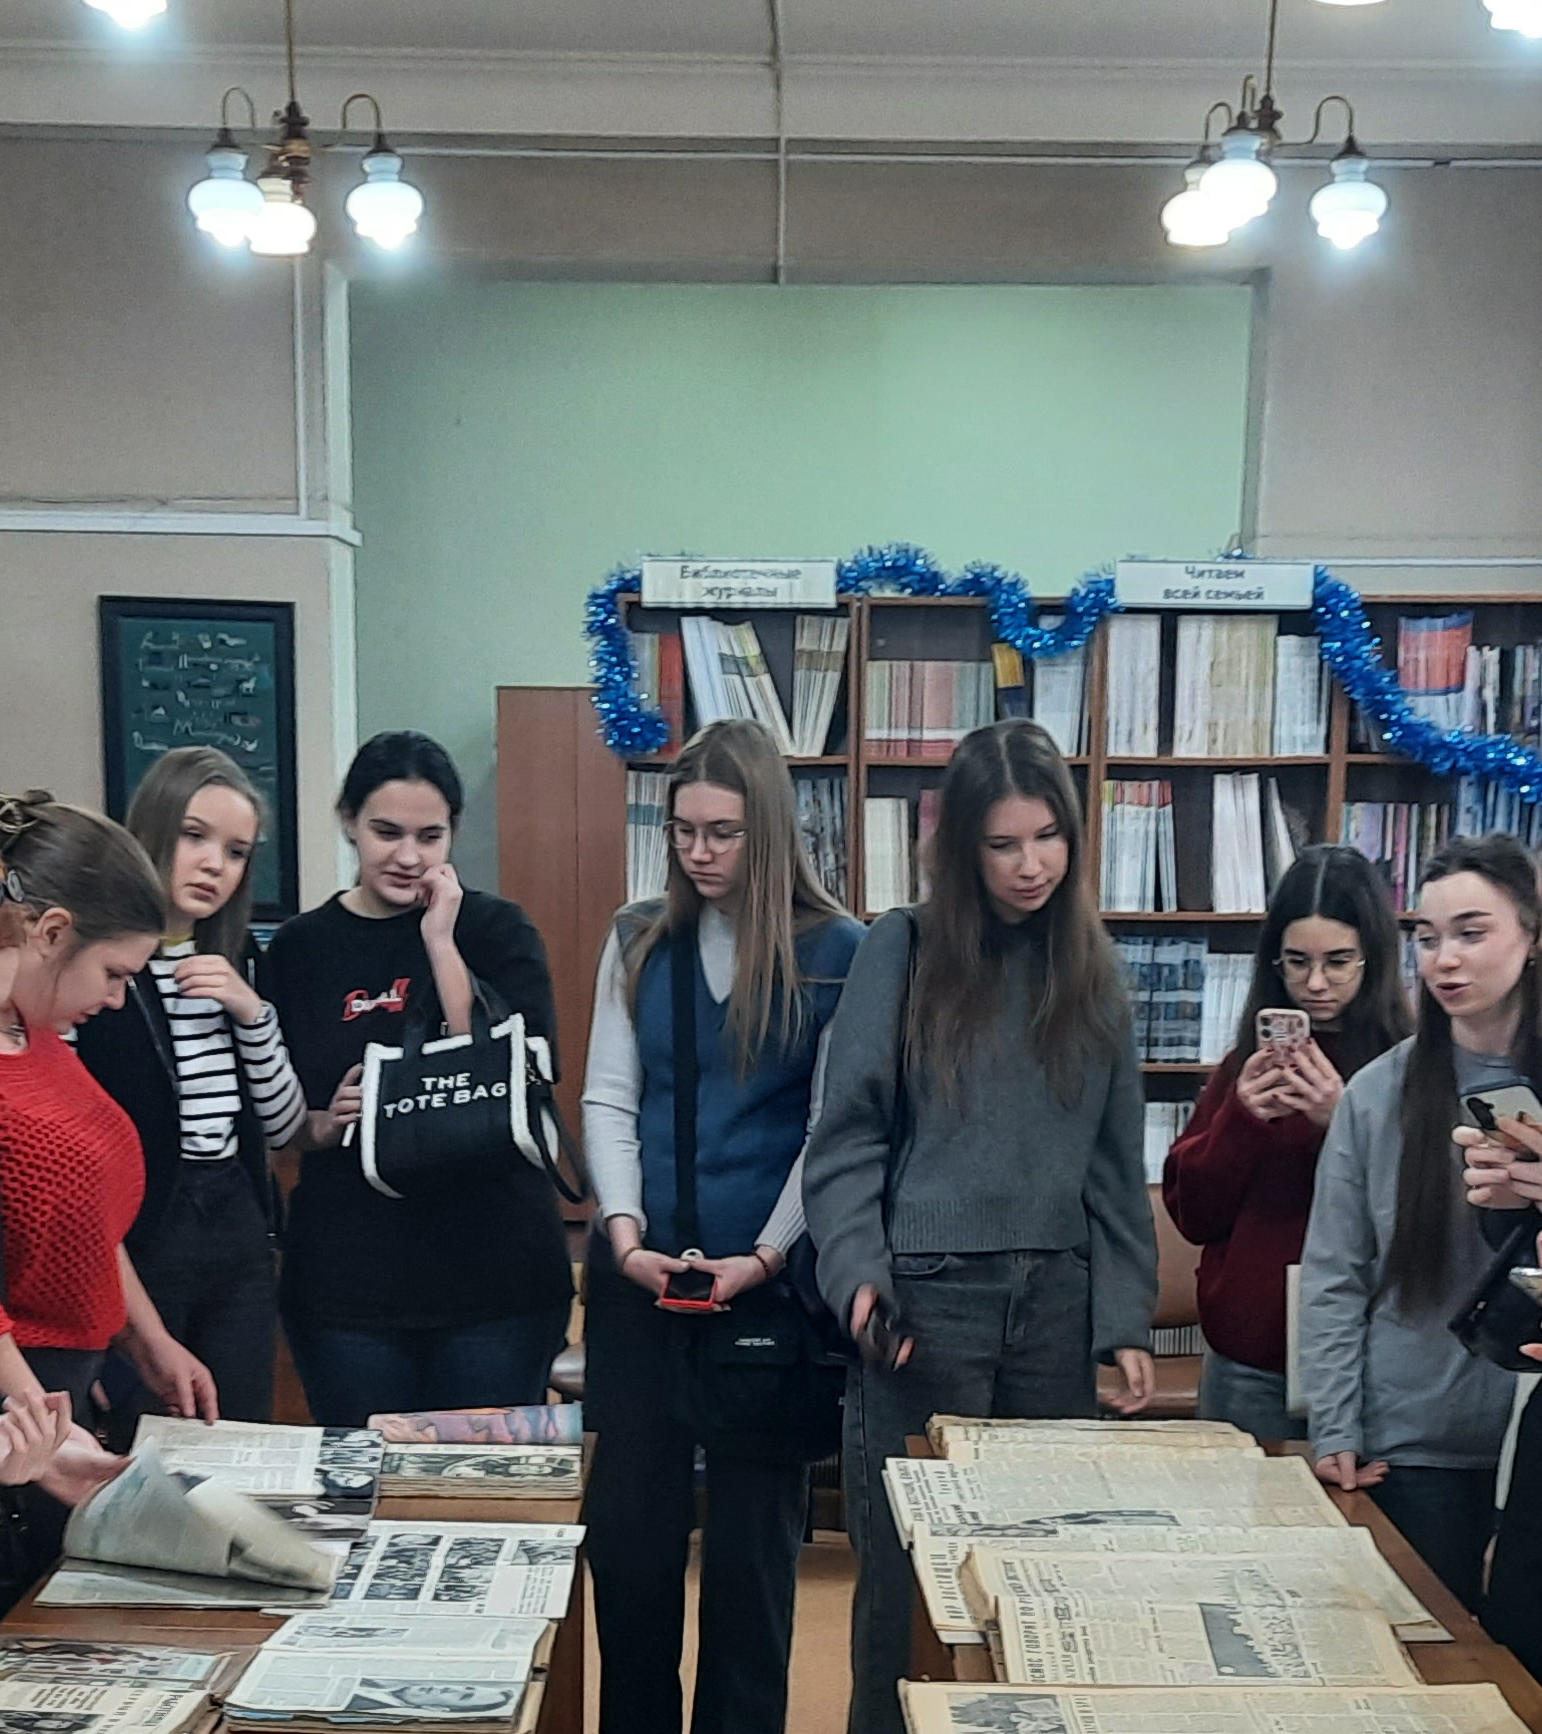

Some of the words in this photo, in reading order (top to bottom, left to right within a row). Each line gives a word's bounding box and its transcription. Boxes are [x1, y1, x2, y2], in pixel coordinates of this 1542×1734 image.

[421, 1072, 472, 1091] THE
[382, 1092, 448, 1119] TOTE
[453, 1082, 508, 1104] BAG
